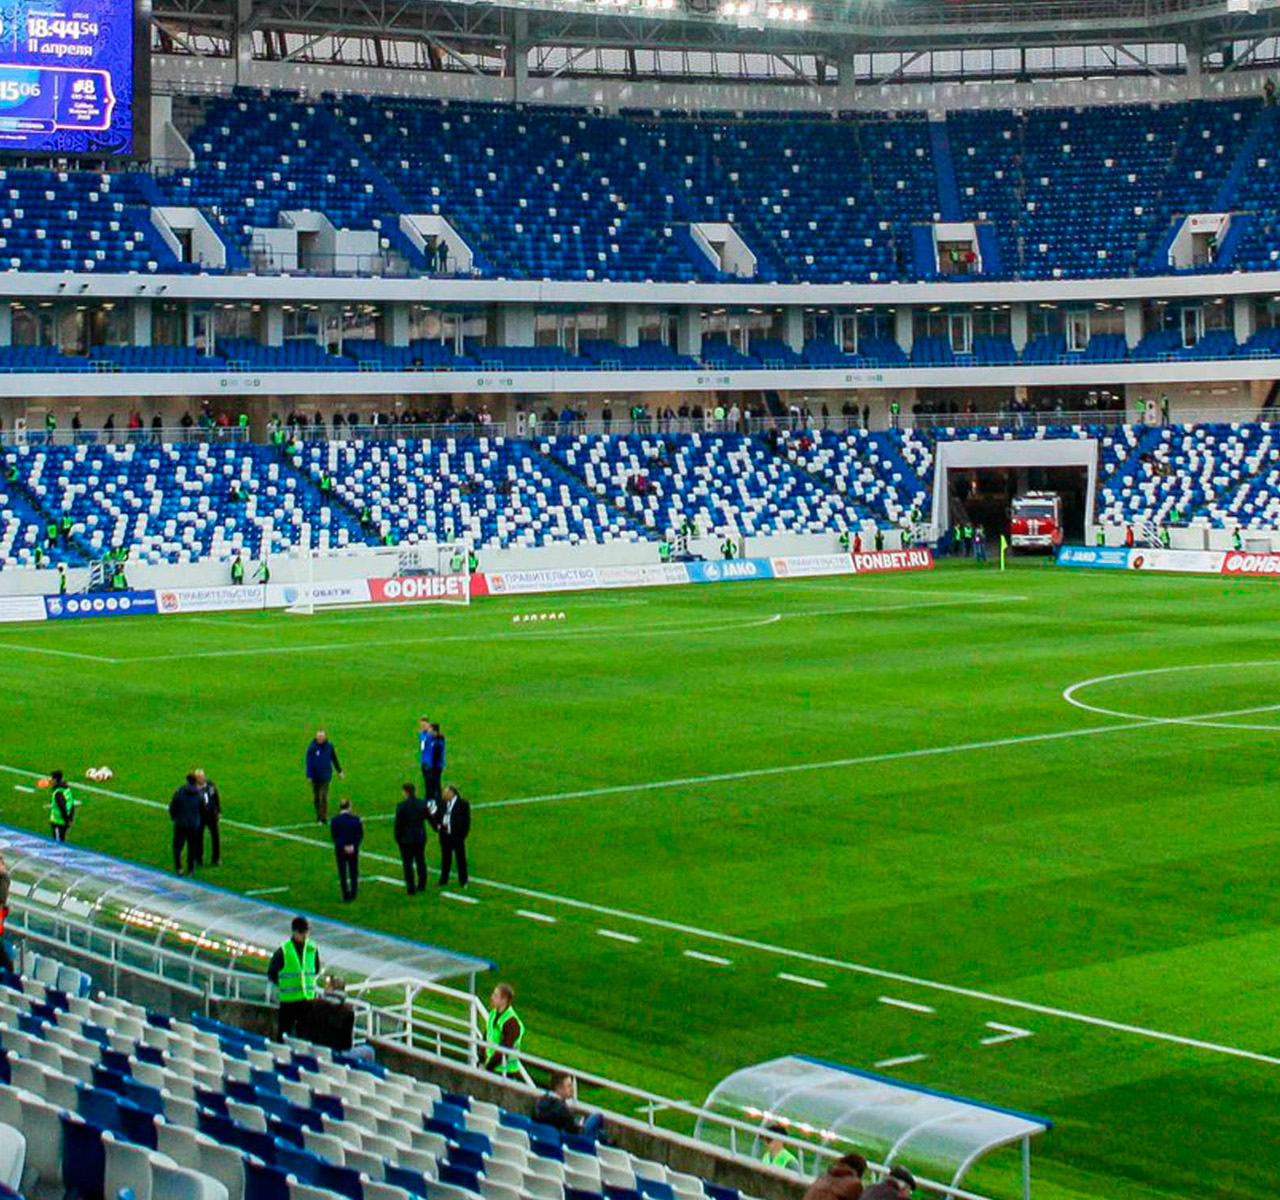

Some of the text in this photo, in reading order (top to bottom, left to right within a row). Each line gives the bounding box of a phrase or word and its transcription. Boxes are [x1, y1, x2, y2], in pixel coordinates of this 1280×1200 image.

[41, 44, 93, 57] апреля
[20, 83, 41, 97] 06
[855, 551, 929, 569] FONBET.RU
[506, 568, 594, 583] ПРАВИТЕЛЬСТВО
[724, 561, 756, 576] JAKO
[383, 576, 471, 598] ФОНБЕТ
